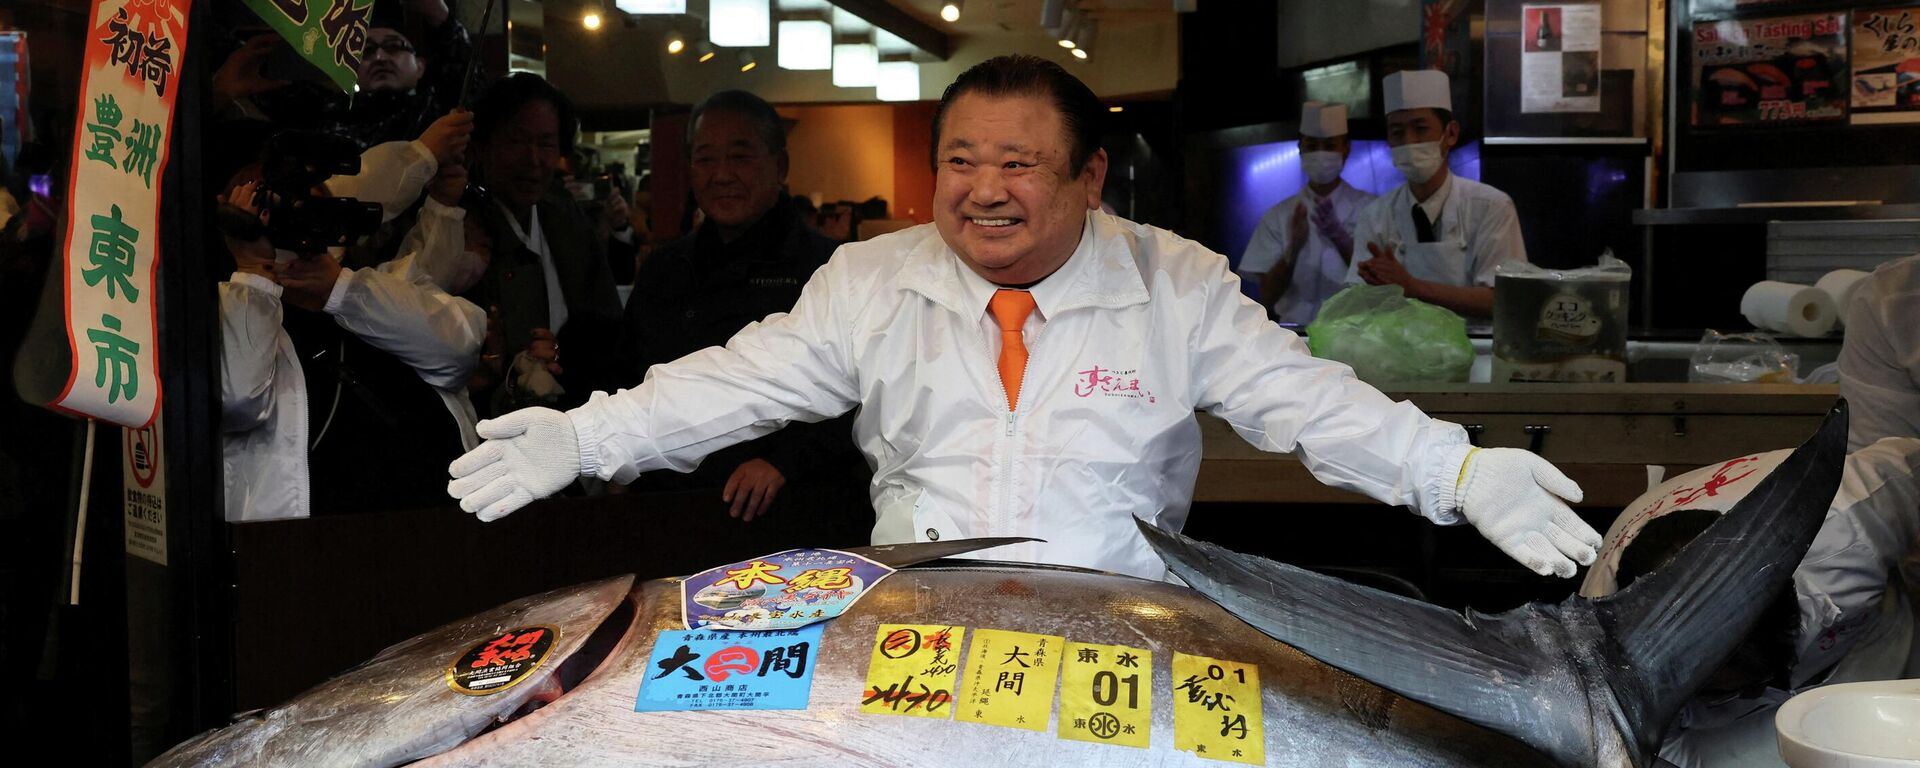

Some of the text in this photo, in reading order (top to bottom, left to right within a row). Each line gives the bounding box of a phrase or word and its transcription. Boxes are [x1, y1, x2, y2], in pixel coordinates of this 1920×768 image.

[1756, 21, 1811, 40] Tasting
[102, 7, 171, 97] 初荷
[85, 93, 162, 190] 豊洲
[1556, 301, 1578, 311] エコ
[682, 633, 731, 642] 青森県産
[1033, 638, 1049, 667] 青森県
[995, 645, 1031, 697] 大間
[698, 684, 749, 692] 西山商店
[1092, 671, 1139, 709] 01
